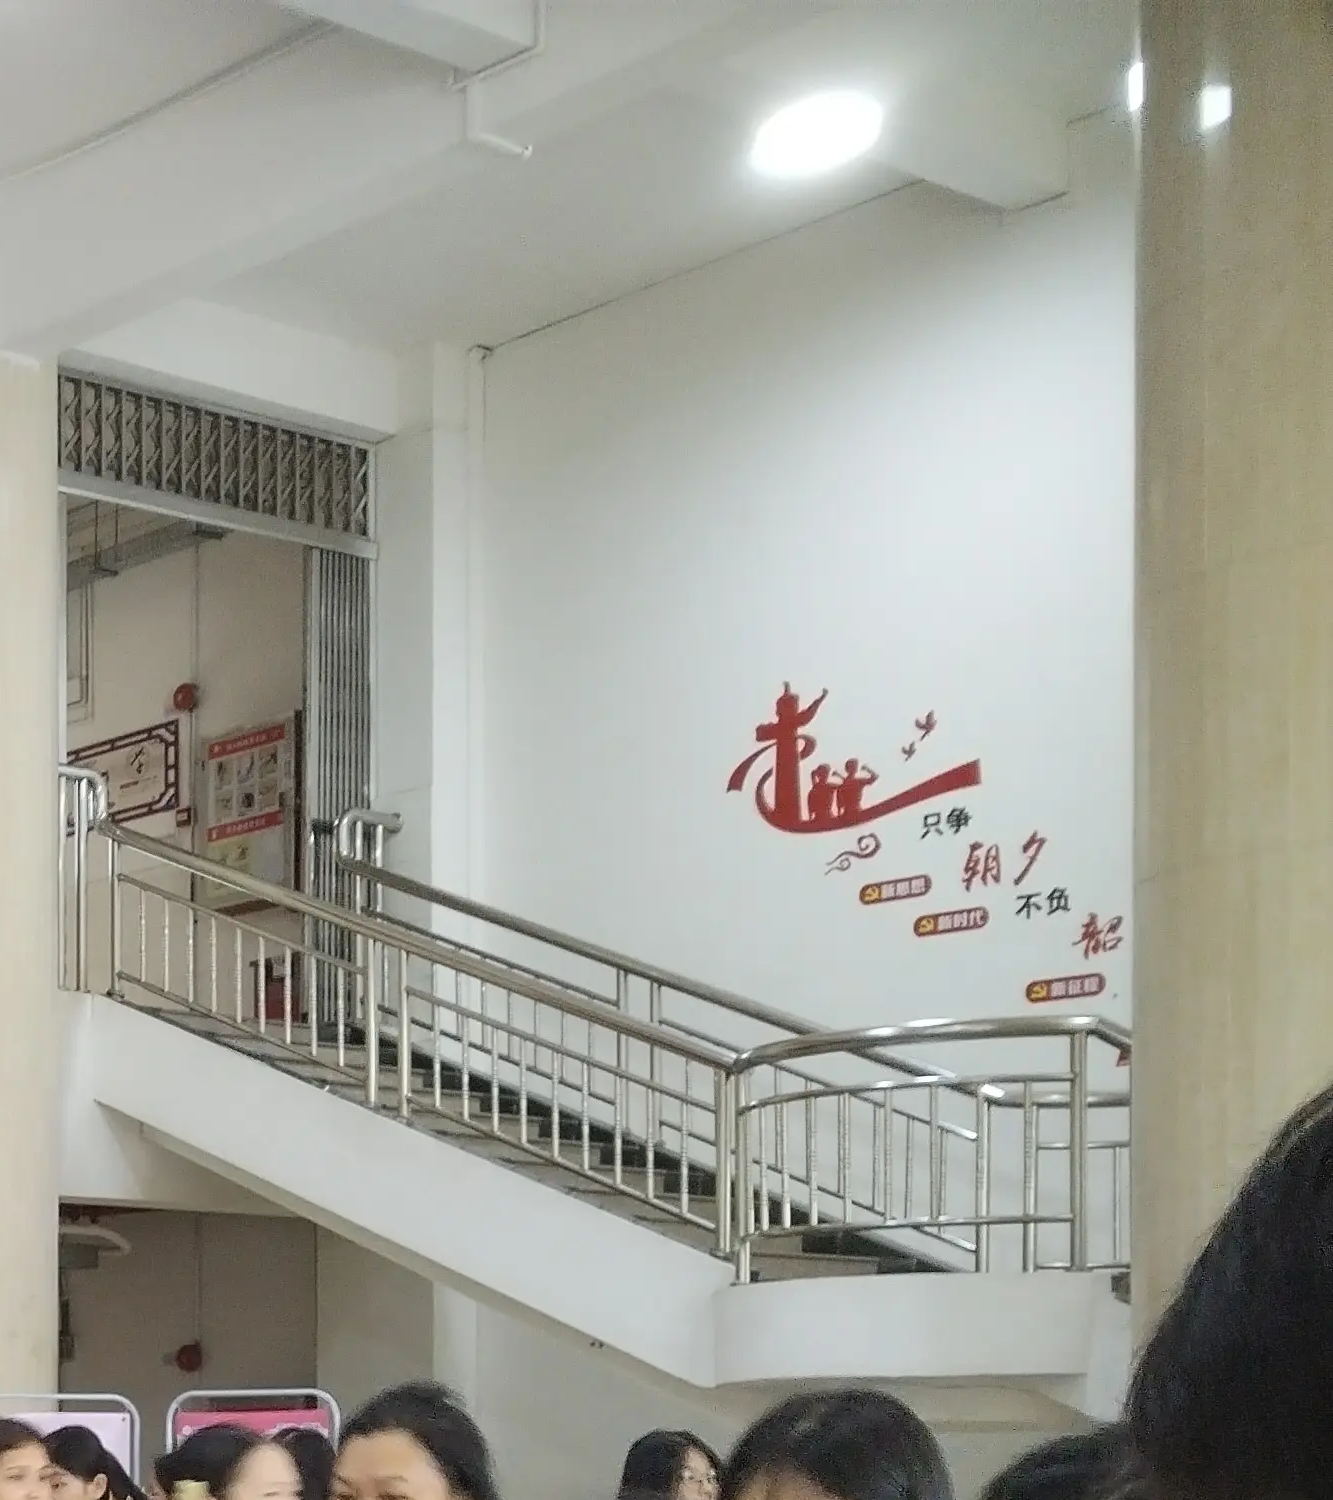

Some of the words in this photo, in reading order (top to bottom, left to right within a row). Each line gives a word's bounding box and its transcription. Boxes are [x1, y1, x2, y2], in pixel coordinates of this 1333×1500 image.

[920, 806, 973, 839] 只争
[961, 830, 1048, 892] 朝夕
[1015, 886, 1072, 920] 不负
